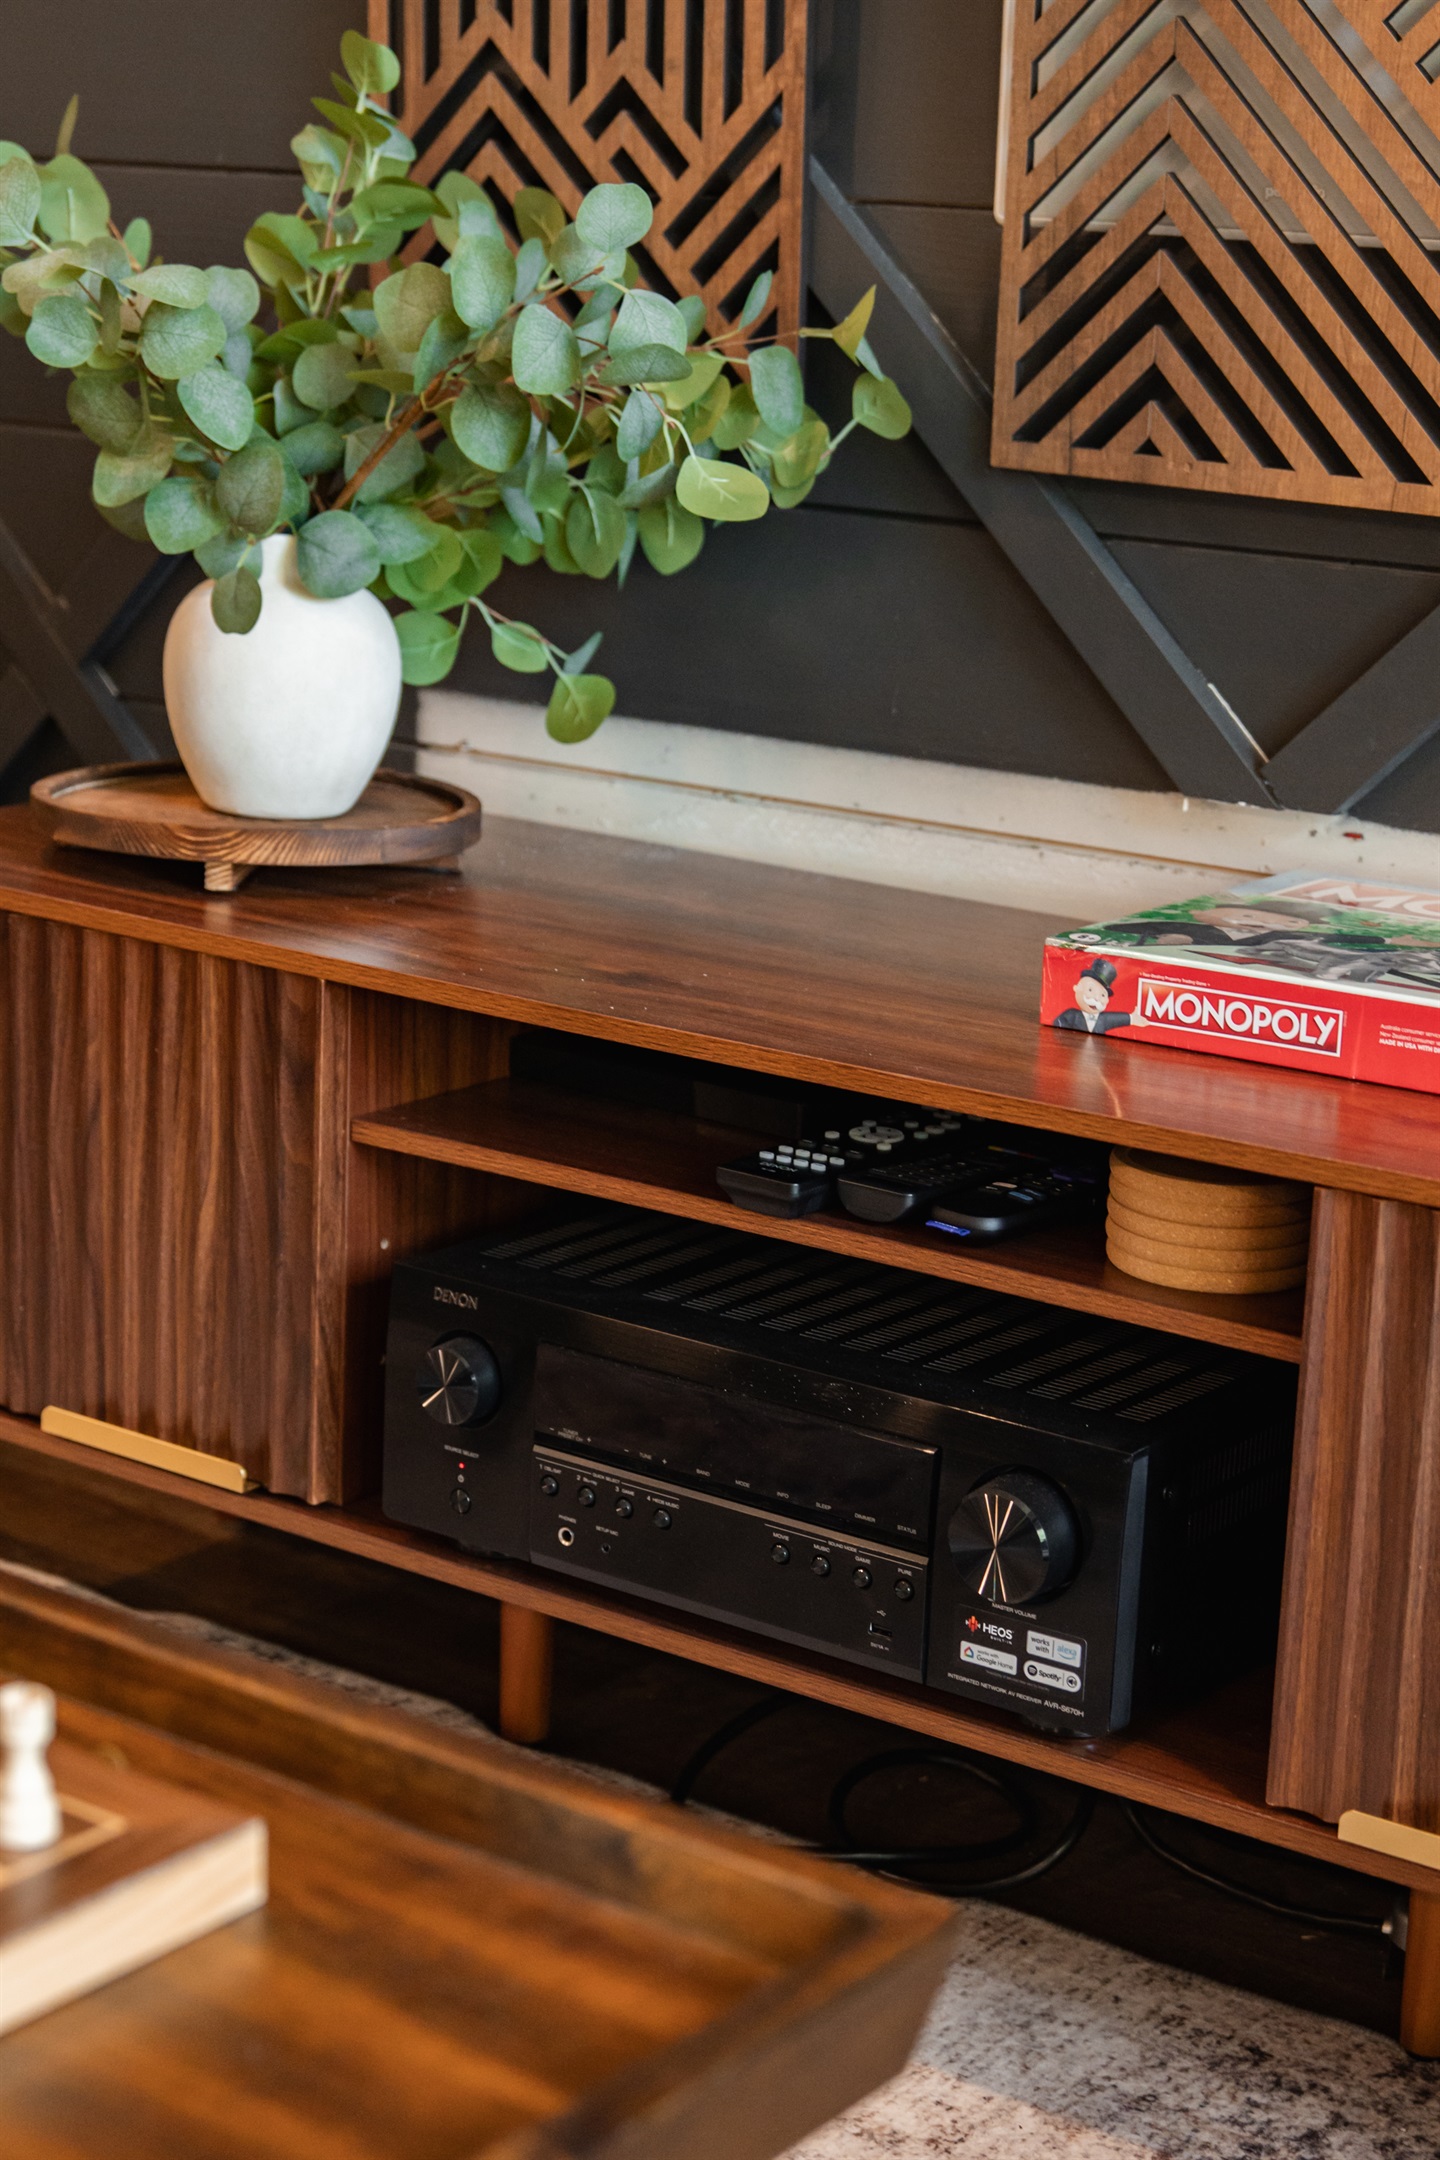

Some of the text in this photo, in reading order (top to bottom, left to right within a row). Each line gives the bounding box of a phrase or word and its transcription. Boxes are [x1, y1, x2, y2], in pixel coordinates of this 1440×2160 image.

[1145, 987, 1337, 1047] MONOPOLY
[1378, 1038, 1397, 1047] MADE
[1396, 1040, 1404, 1048] IN
[1404, 1041, 1417, 1050] USA
[1417, 1044, 1433, 1053] WITH
[433, 1286, 479, 1310] DENON
[776, 1491, 790, 1499] INFO
[815, 1501, 832, 1511] SLEEP
[772, 1531, 790, 1541] MOVIE
[896, 1524, 917, 1535] STATUS
[992, 1602, 1037, 1620] MASTER VOLUME
[982, 1622, 1013, 1640] HEOS
[1031, 1636, 1050, 1647] works
[1035, 1645, 1050, 1654] with
[1056, 1644, 1077, 1657] alexa
[976, 1654, 1014, 1670] Google Home
[1038, 1669, 1061, 1682] Spotify
[947, 1672, 980, 1687] INTEGRATED
[980, 1682, 1007, 1695] NETWORK
[1007, 1690, 1016, 1698] AV
[1016, 1692, 1042, 1705] RECEIVER
